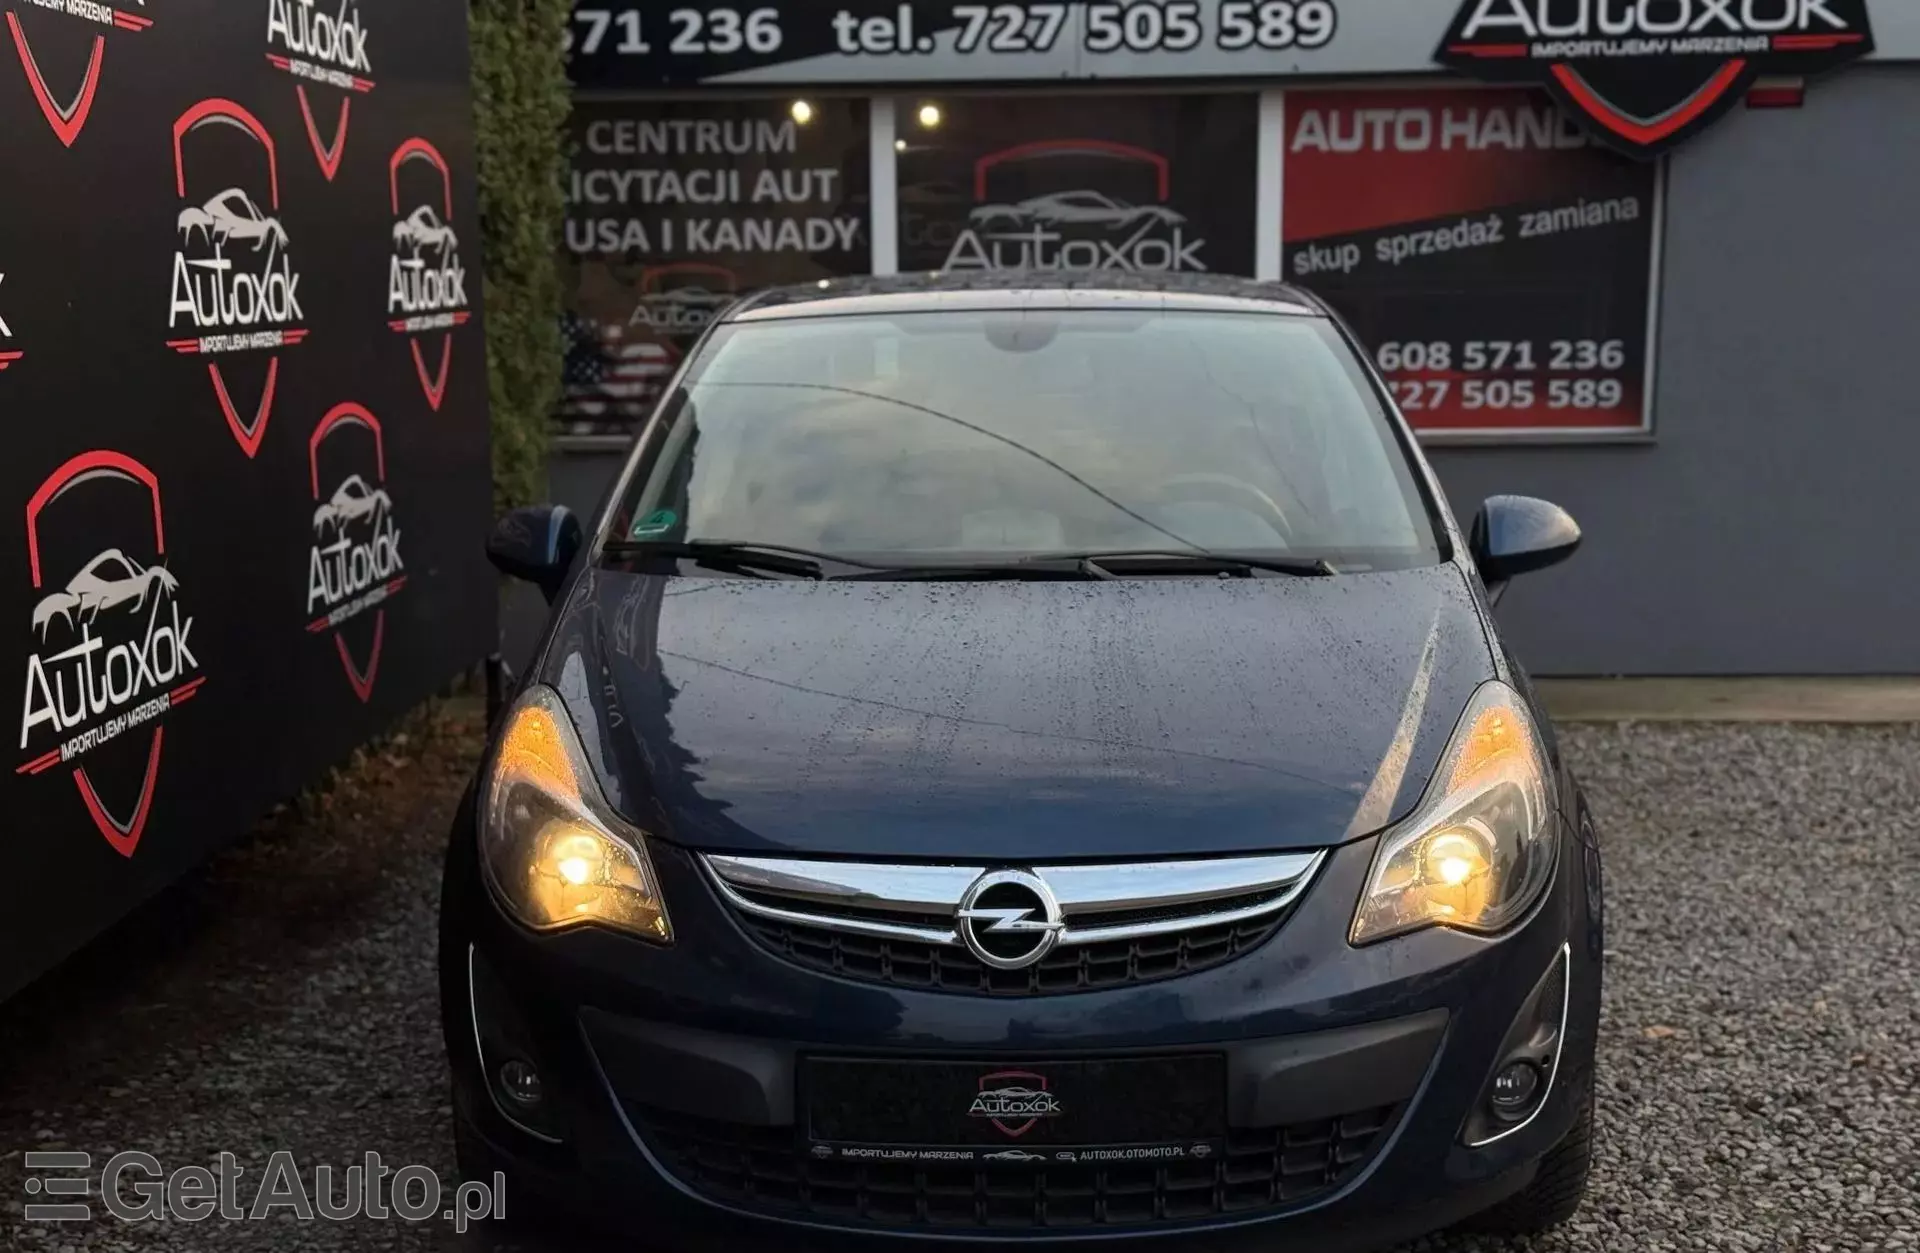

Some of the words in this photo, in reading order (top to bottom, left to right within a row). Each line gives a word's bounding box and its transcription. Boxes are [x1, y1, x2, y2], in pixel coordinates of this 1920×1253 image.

[669, 9, 782, 54] 236
[832, 4, 932, 52] tel.
[952, 5, 1068, 50] 727
[1086, 3, 1200, 49] 505
[1217, 1, 1336, 48] 589
[1532, 37, 1668, 58] IMPORTUJEMY
[1670, 35, 1769, 54] MARZENIA
[586, 120, 797, 154] CENTRUM
[1292, 108, 1430, 153] AUTO
[564, 169, 740, 203] ICYTACJI
[753, 168, 839, 203] AUT
[566, 218, 651, 253] USA
[661, 218, 673, 252] I
[686, 218, 860, 252] KANADY
[941, 215, 1206, 272] Autoxok
[1293, 242, 1360, 275] skup
[1376, 214, 1505, 265] sprzedaż
[1519, 196, 1640, 238] zamiana
[169, 242, 304, 328] Autoxok
[388, 246, 468, 314] Autoxok
[1377, 341, 1451, 373] 608
[1462, 341, 1536, 372] 571
[1548, 340, 1625, 371] 236
[1461, 380, 1535, 410] 505
[1547, 379, 1622, 409] 589
[307, 516, 404, 614] Autoxok
[20, 598, 199, 749] Autoxok
[61, 715, 127, 763] IMPORTUJEMY
[127, 693, 171, 728] MARZENIA
[969, 1096, 1061, 1113] Autoxok
[842, 1147, 918, 1159] IMPORTUJEMY
[919, 1151, 974, 1160] MARZENIA
[1080, 1146, 1186, 1161] AUTOXOK.OTOMOTO.PL
